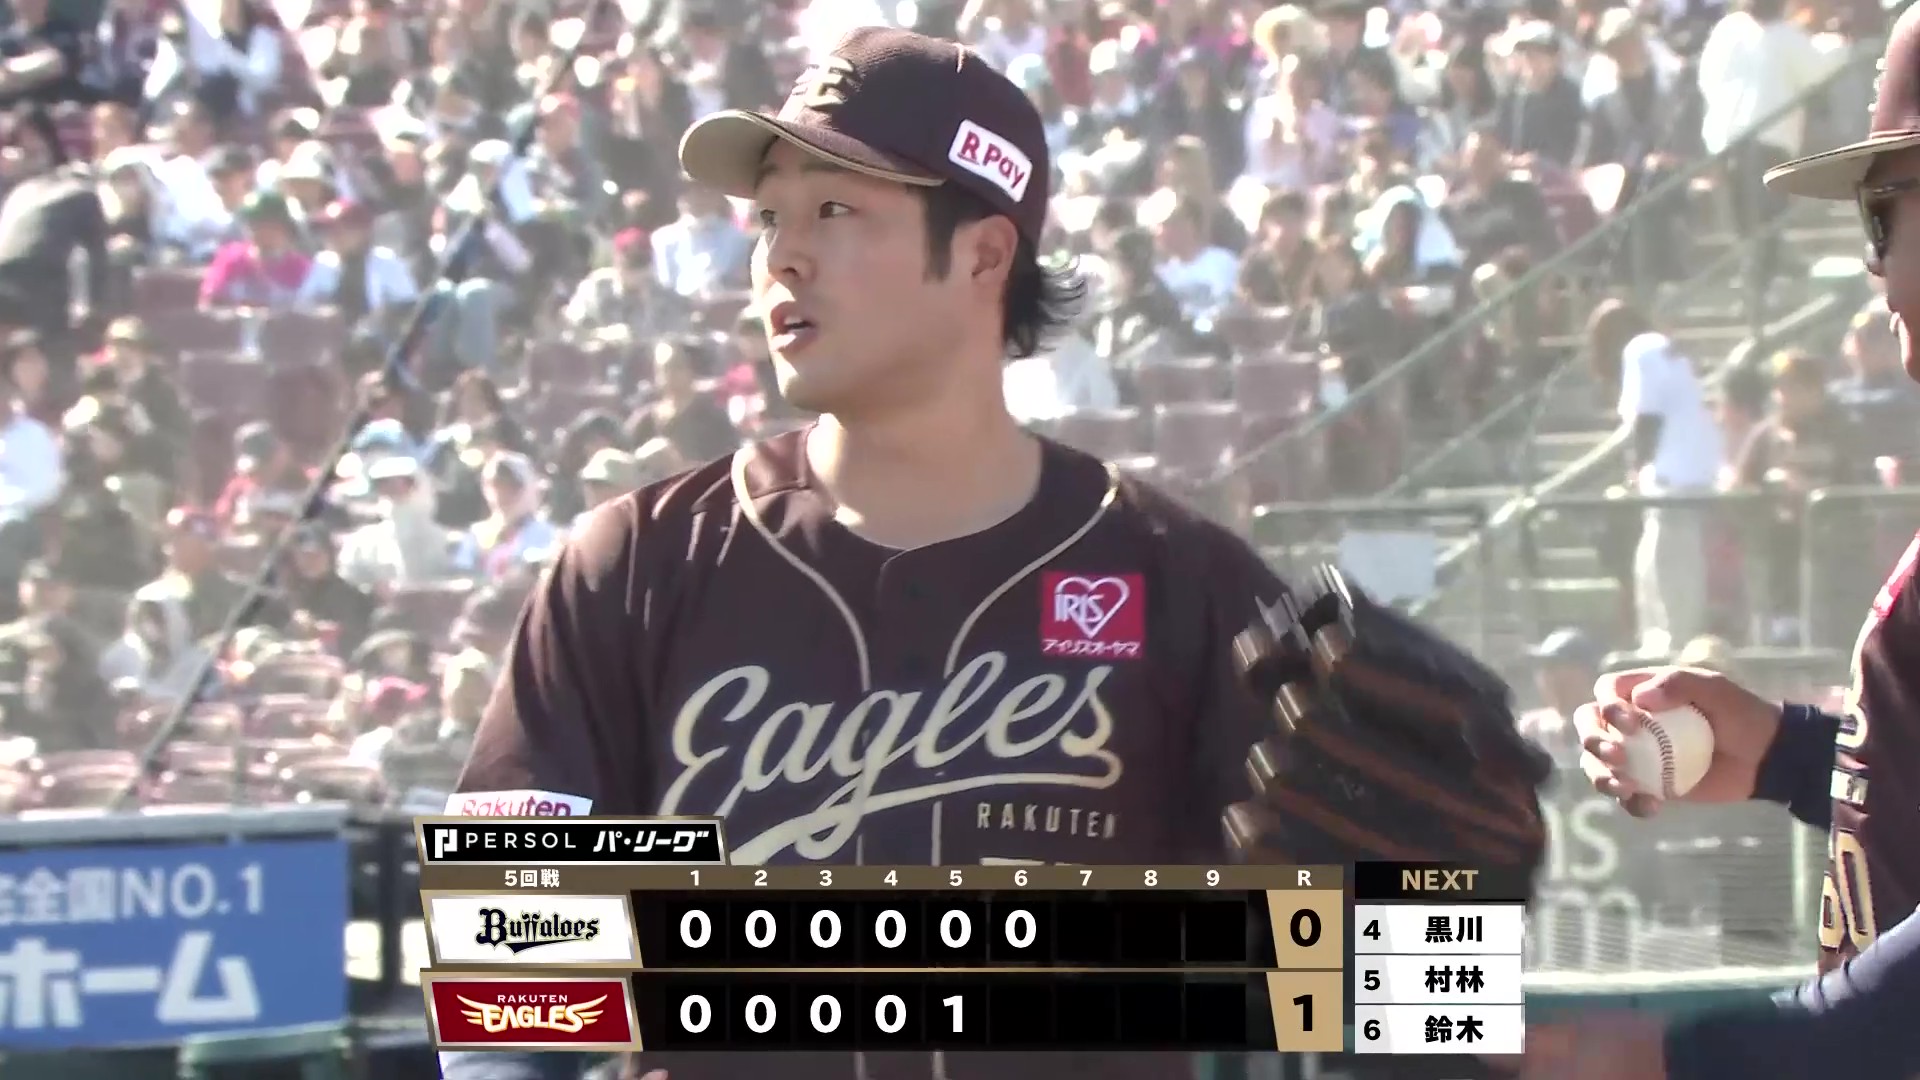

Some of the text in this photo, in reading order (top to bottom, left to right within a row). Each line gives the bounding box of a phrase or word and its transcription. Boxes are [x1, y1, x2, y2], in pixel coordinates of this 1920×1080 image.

[958, 130, 1025, 190] R Pay
[1053, 594, 1105, 622] IRIS
[657, 650, 1122, 860] Eagles
[461, 793, 572, 817] Rakuten
